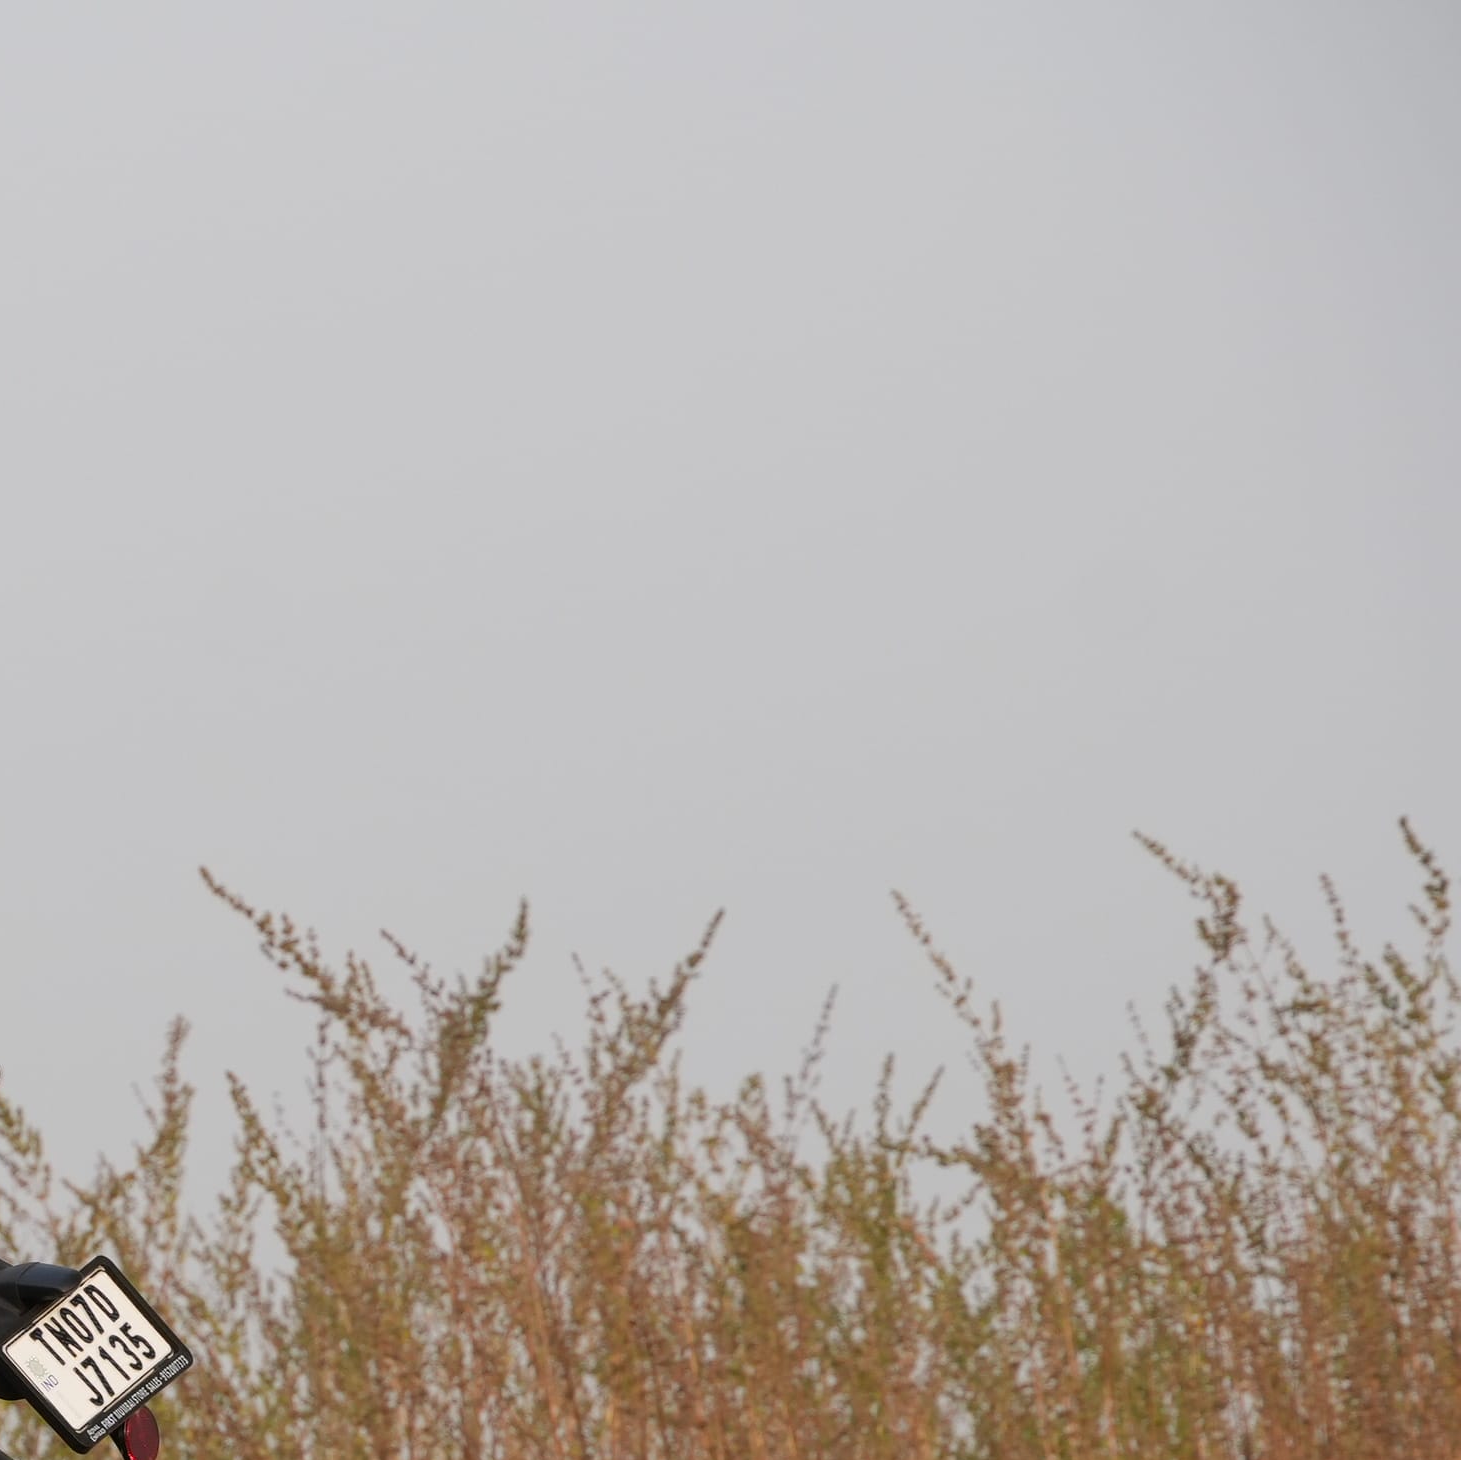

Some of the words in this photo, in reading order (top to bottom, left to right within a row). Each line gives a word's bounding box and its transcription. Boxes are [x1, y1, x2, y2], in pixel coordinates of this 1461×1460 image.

[73, 1322, 156, 1407] J7135
[40, 1374, 59, 1392] IND
[100, 1413, 118, 1430] FIRST
